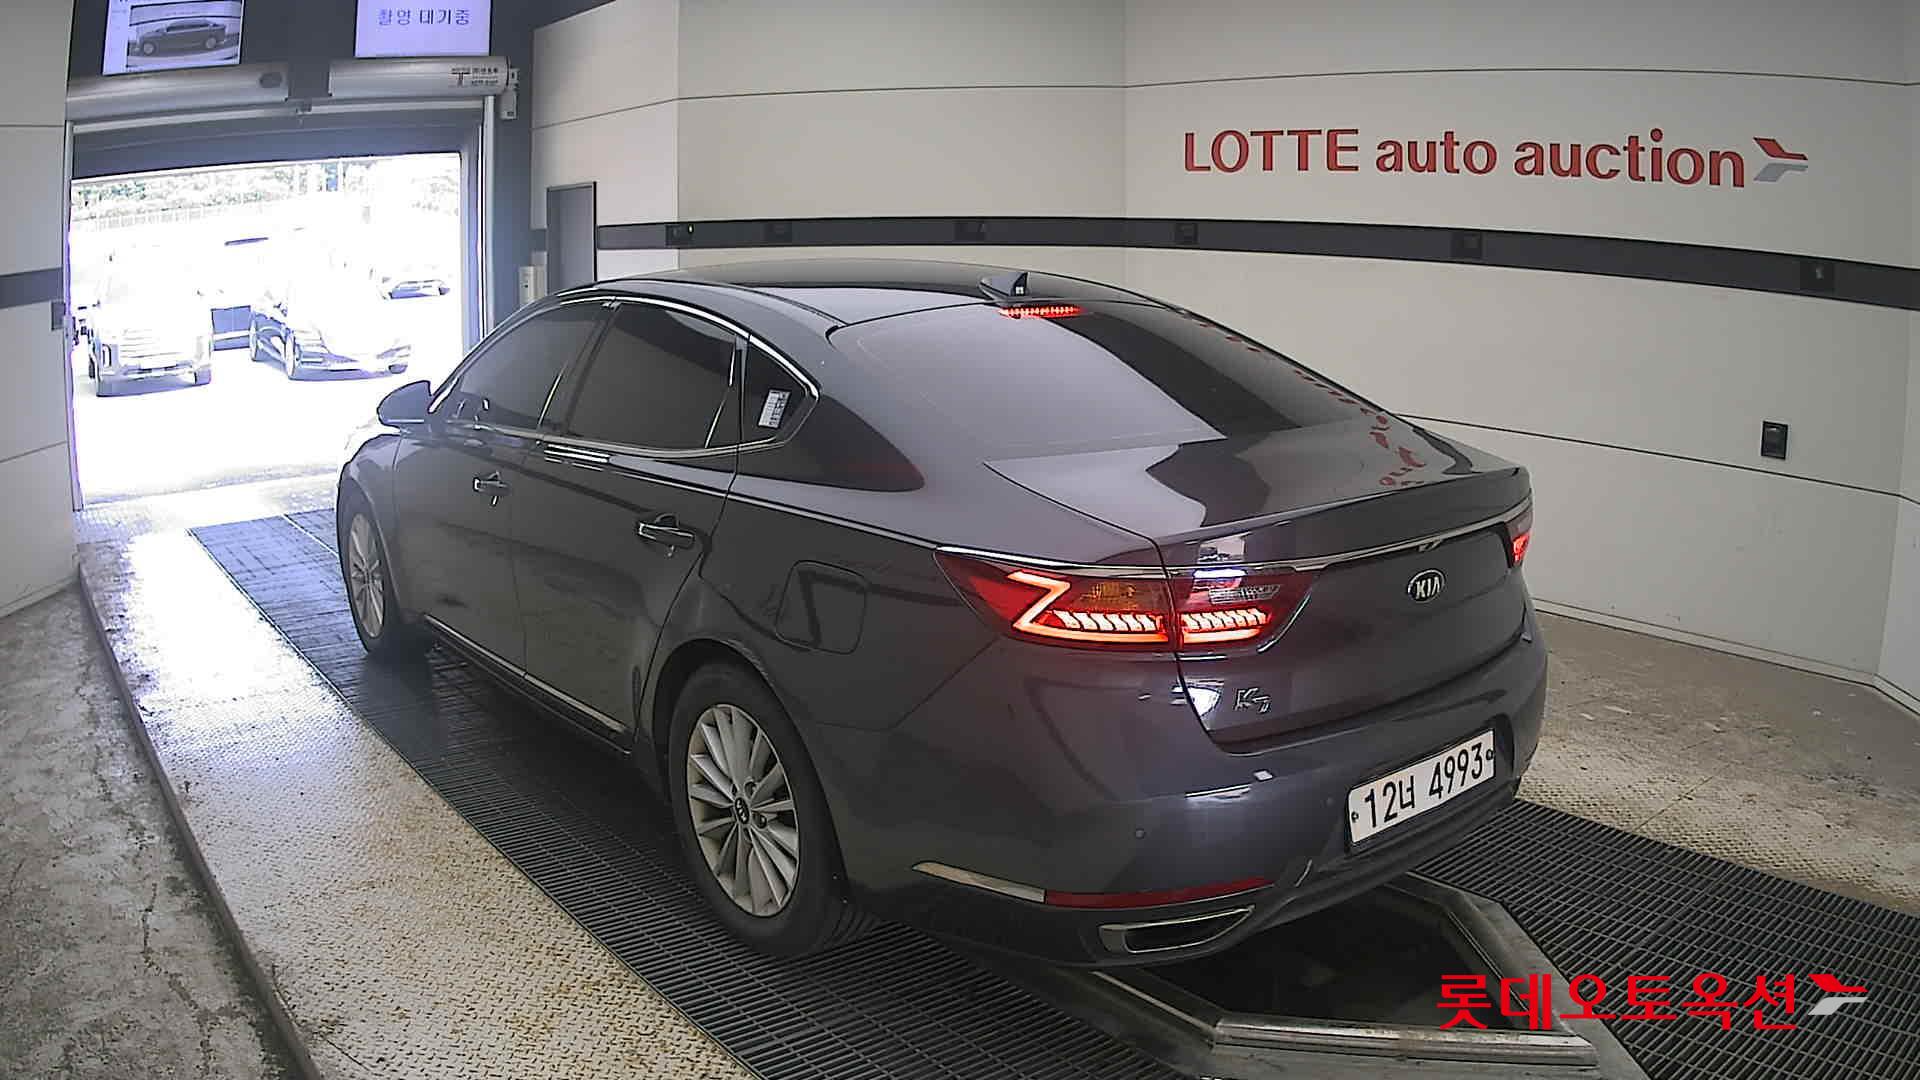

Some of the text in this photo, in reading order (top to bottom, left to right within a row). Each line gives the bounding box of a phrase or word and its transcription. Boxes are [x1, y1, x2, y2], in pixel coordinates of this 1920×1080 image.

[419, 8, 470, 26] 대기중
[1184, 128, 1745, 187] LOTTE auto auction
[1415, 576, 1441, 600] KIA
[1233, 687, 1271, 713] K7
[1364, 742, 1483, 828] 12너 4993
